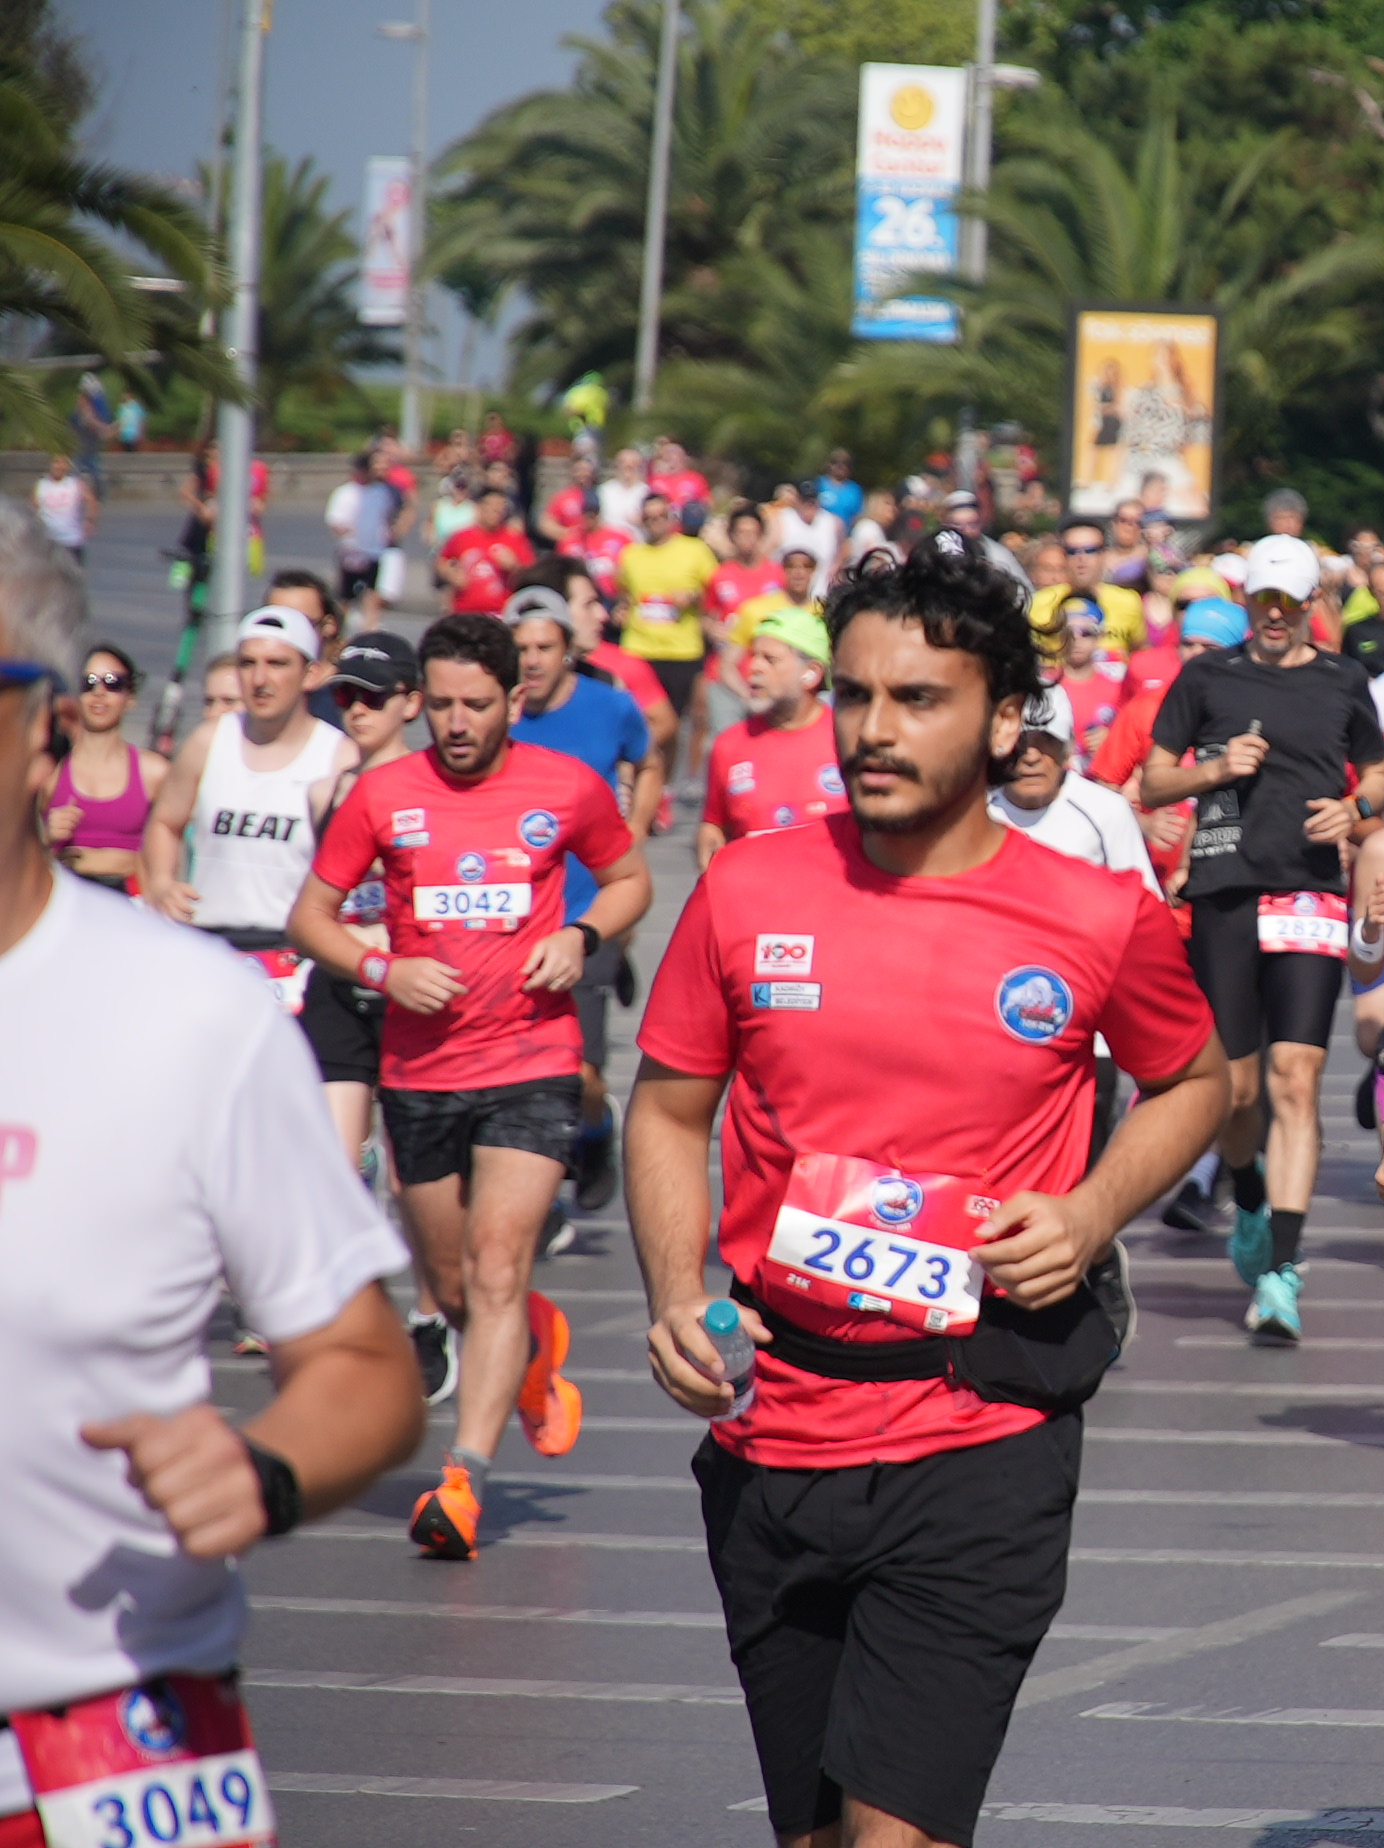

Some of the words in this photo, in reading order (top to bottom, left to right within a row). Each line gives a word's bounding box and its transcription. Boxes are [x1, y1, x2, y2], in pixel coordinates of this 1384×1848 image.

[211, 810, 302, 841] BEAT
[434, 890, 512, 915] 3042
[1276, 919, 1335, 938] 2827
[752, 986, 769, 1004] K
[803, 1228, 953, 1300] 2673
[92, 1767, 252, 1848] 3049
